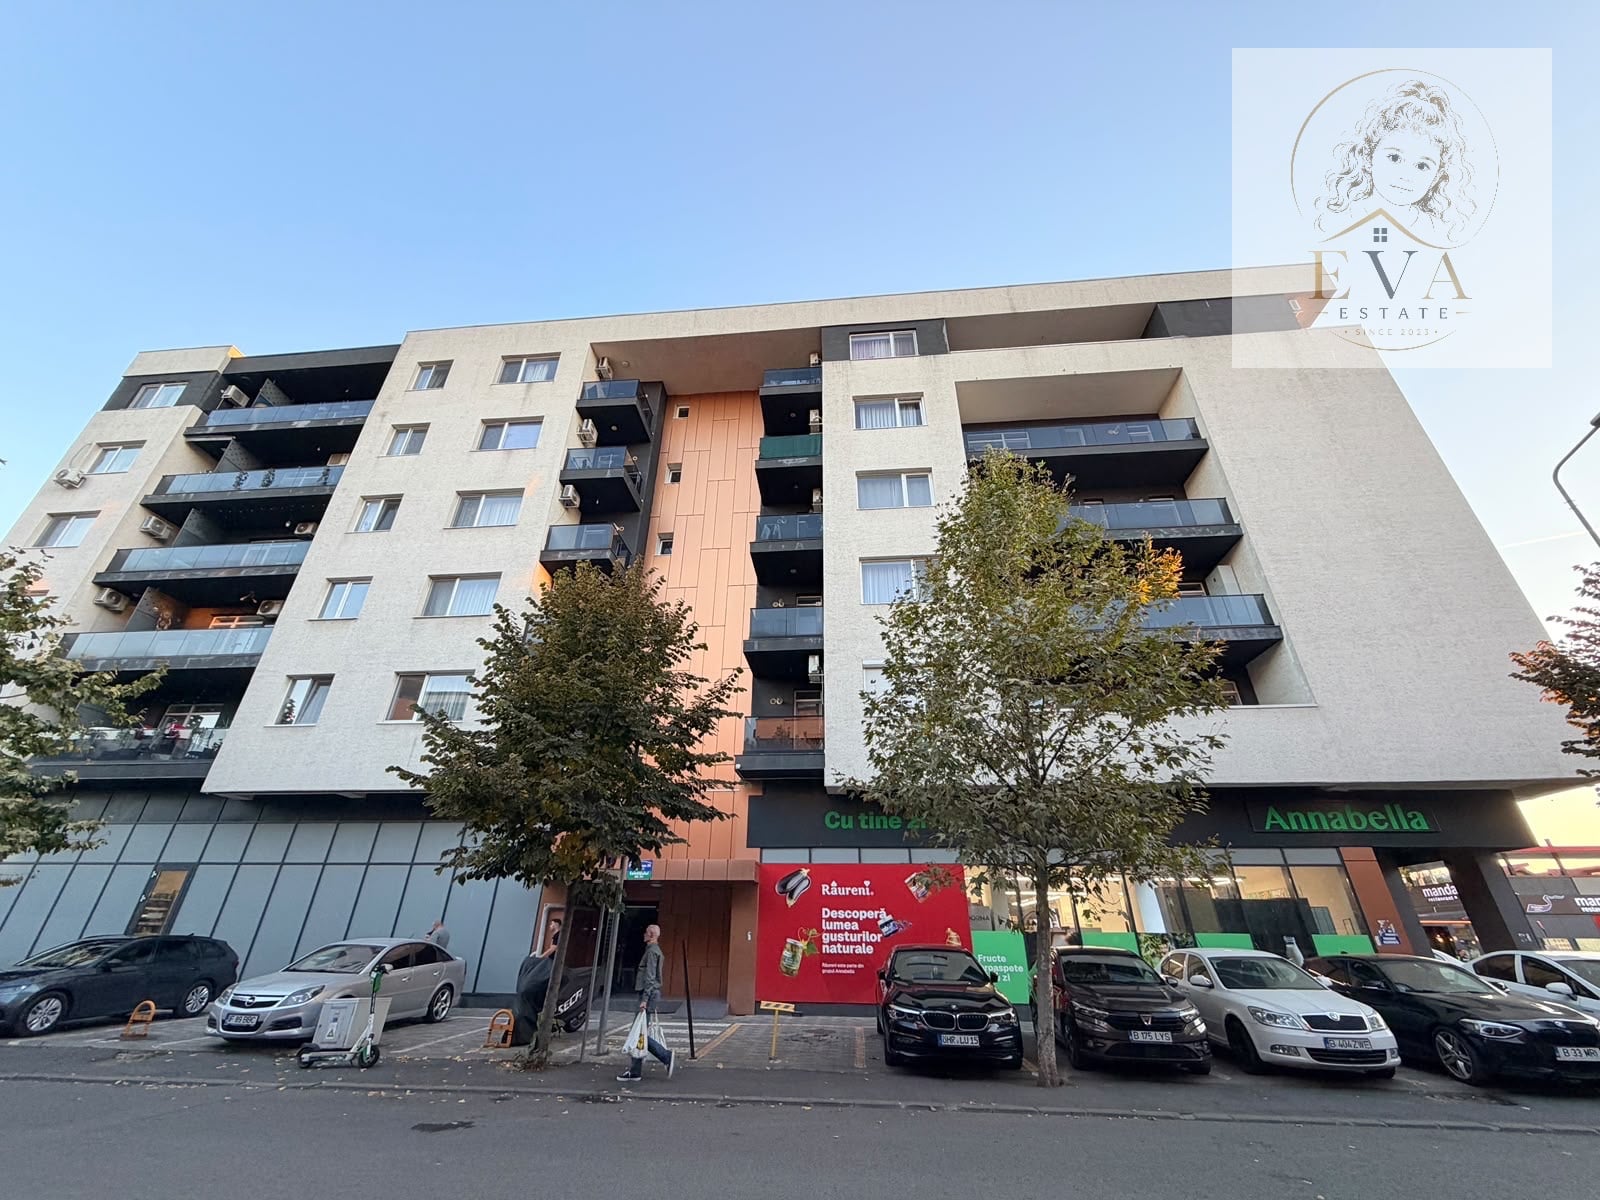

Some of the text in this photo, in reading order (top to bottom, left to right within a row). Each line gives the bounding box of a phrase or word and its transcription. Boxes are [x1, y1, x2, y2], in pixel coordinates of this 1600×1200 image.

[824, 810, 854, 830] Cu
[857, 811, 902, 830] tine
[1265, 803, 1430, 831] Annabella
[821, 908, 887, 920] Descoperă
[822, 919, 859, 930] lumea
[822, 931, 882, 944] gusturilor
[822, 943, 874, 954] naturale
[977, 954, 1007, 963] Fructe
[1132, 1031, 1140, 1040] B
[1154, 1031, 1171, 1041] LYS
[1328, 1039, 1337, 1048] B
[1562, 1047, 1570, 1057] B
